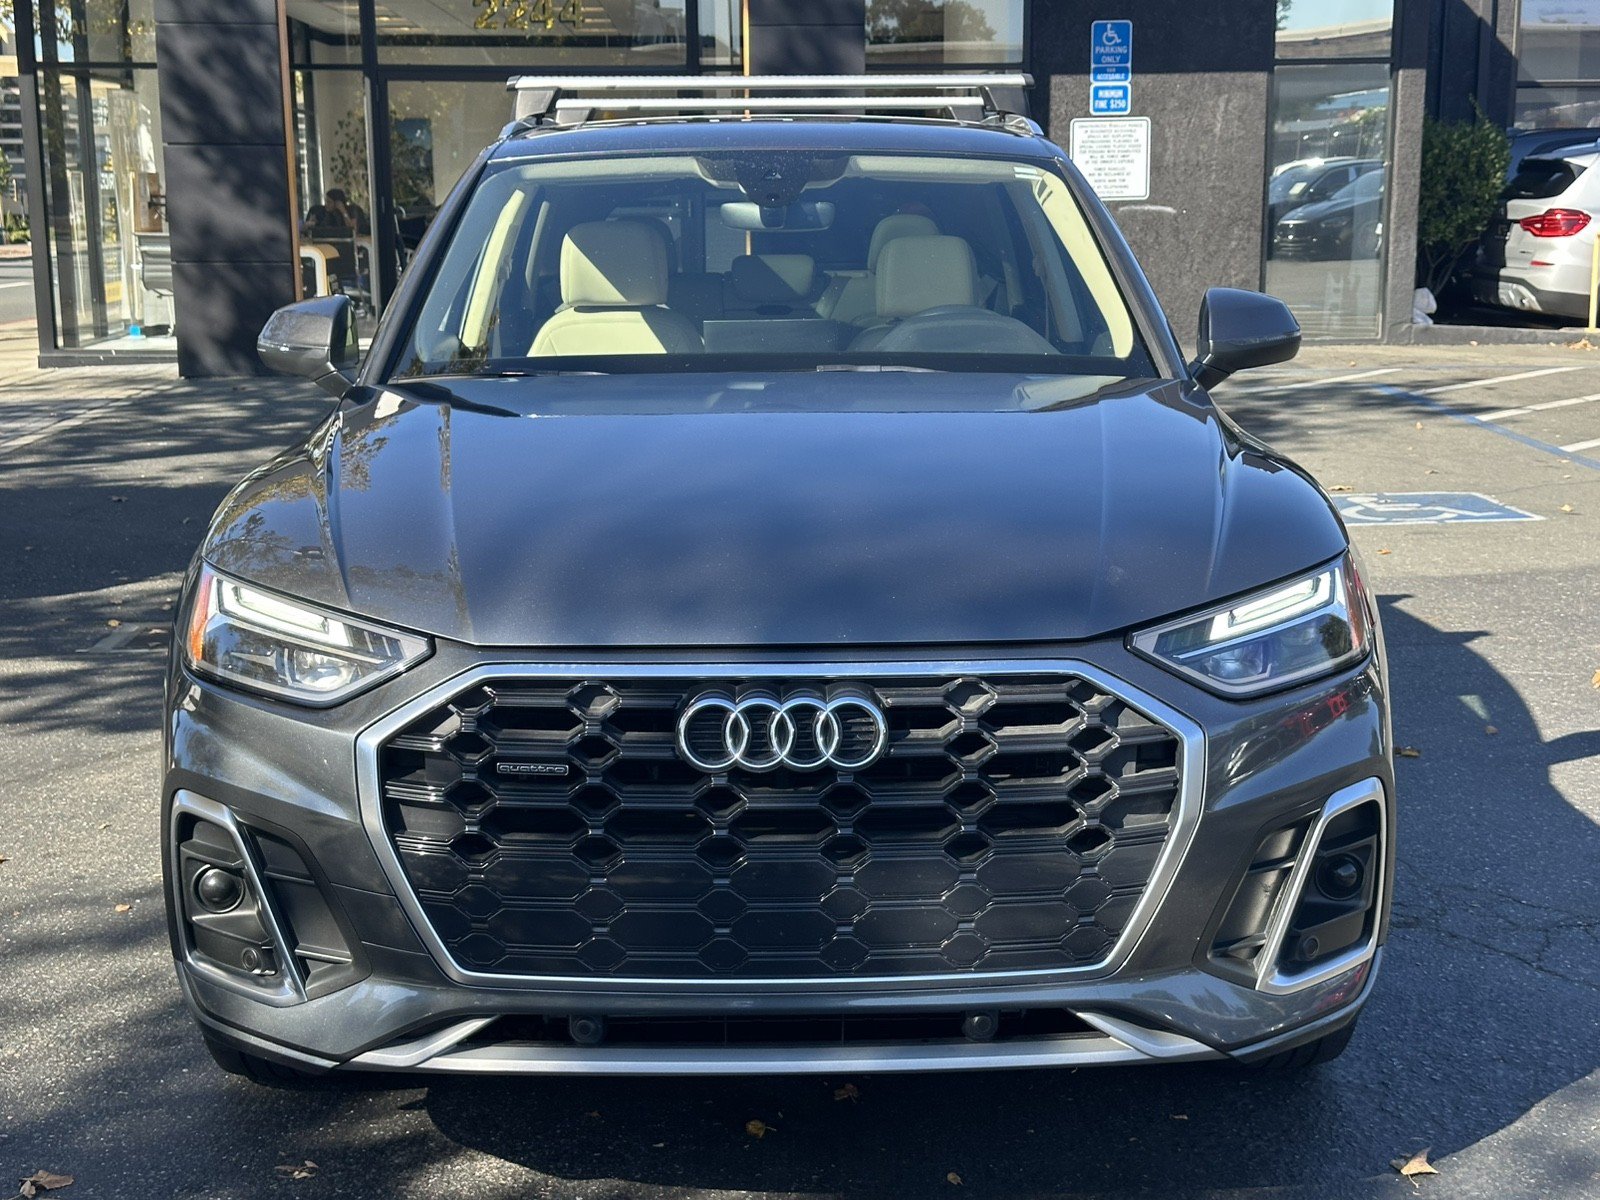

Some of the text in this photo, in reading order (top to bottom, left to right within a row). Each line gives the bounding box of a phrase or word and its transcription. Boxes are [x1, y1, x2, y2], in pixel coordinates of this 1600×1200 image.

[472, 0, 582, 29] 2244
[1095, 46, 1128, 54] PARKING
[1101, 55, 1121, 63] ONLY
[1094, 99, 1127, 109] FINE $250
[499, 765, 566, 773] quattro
